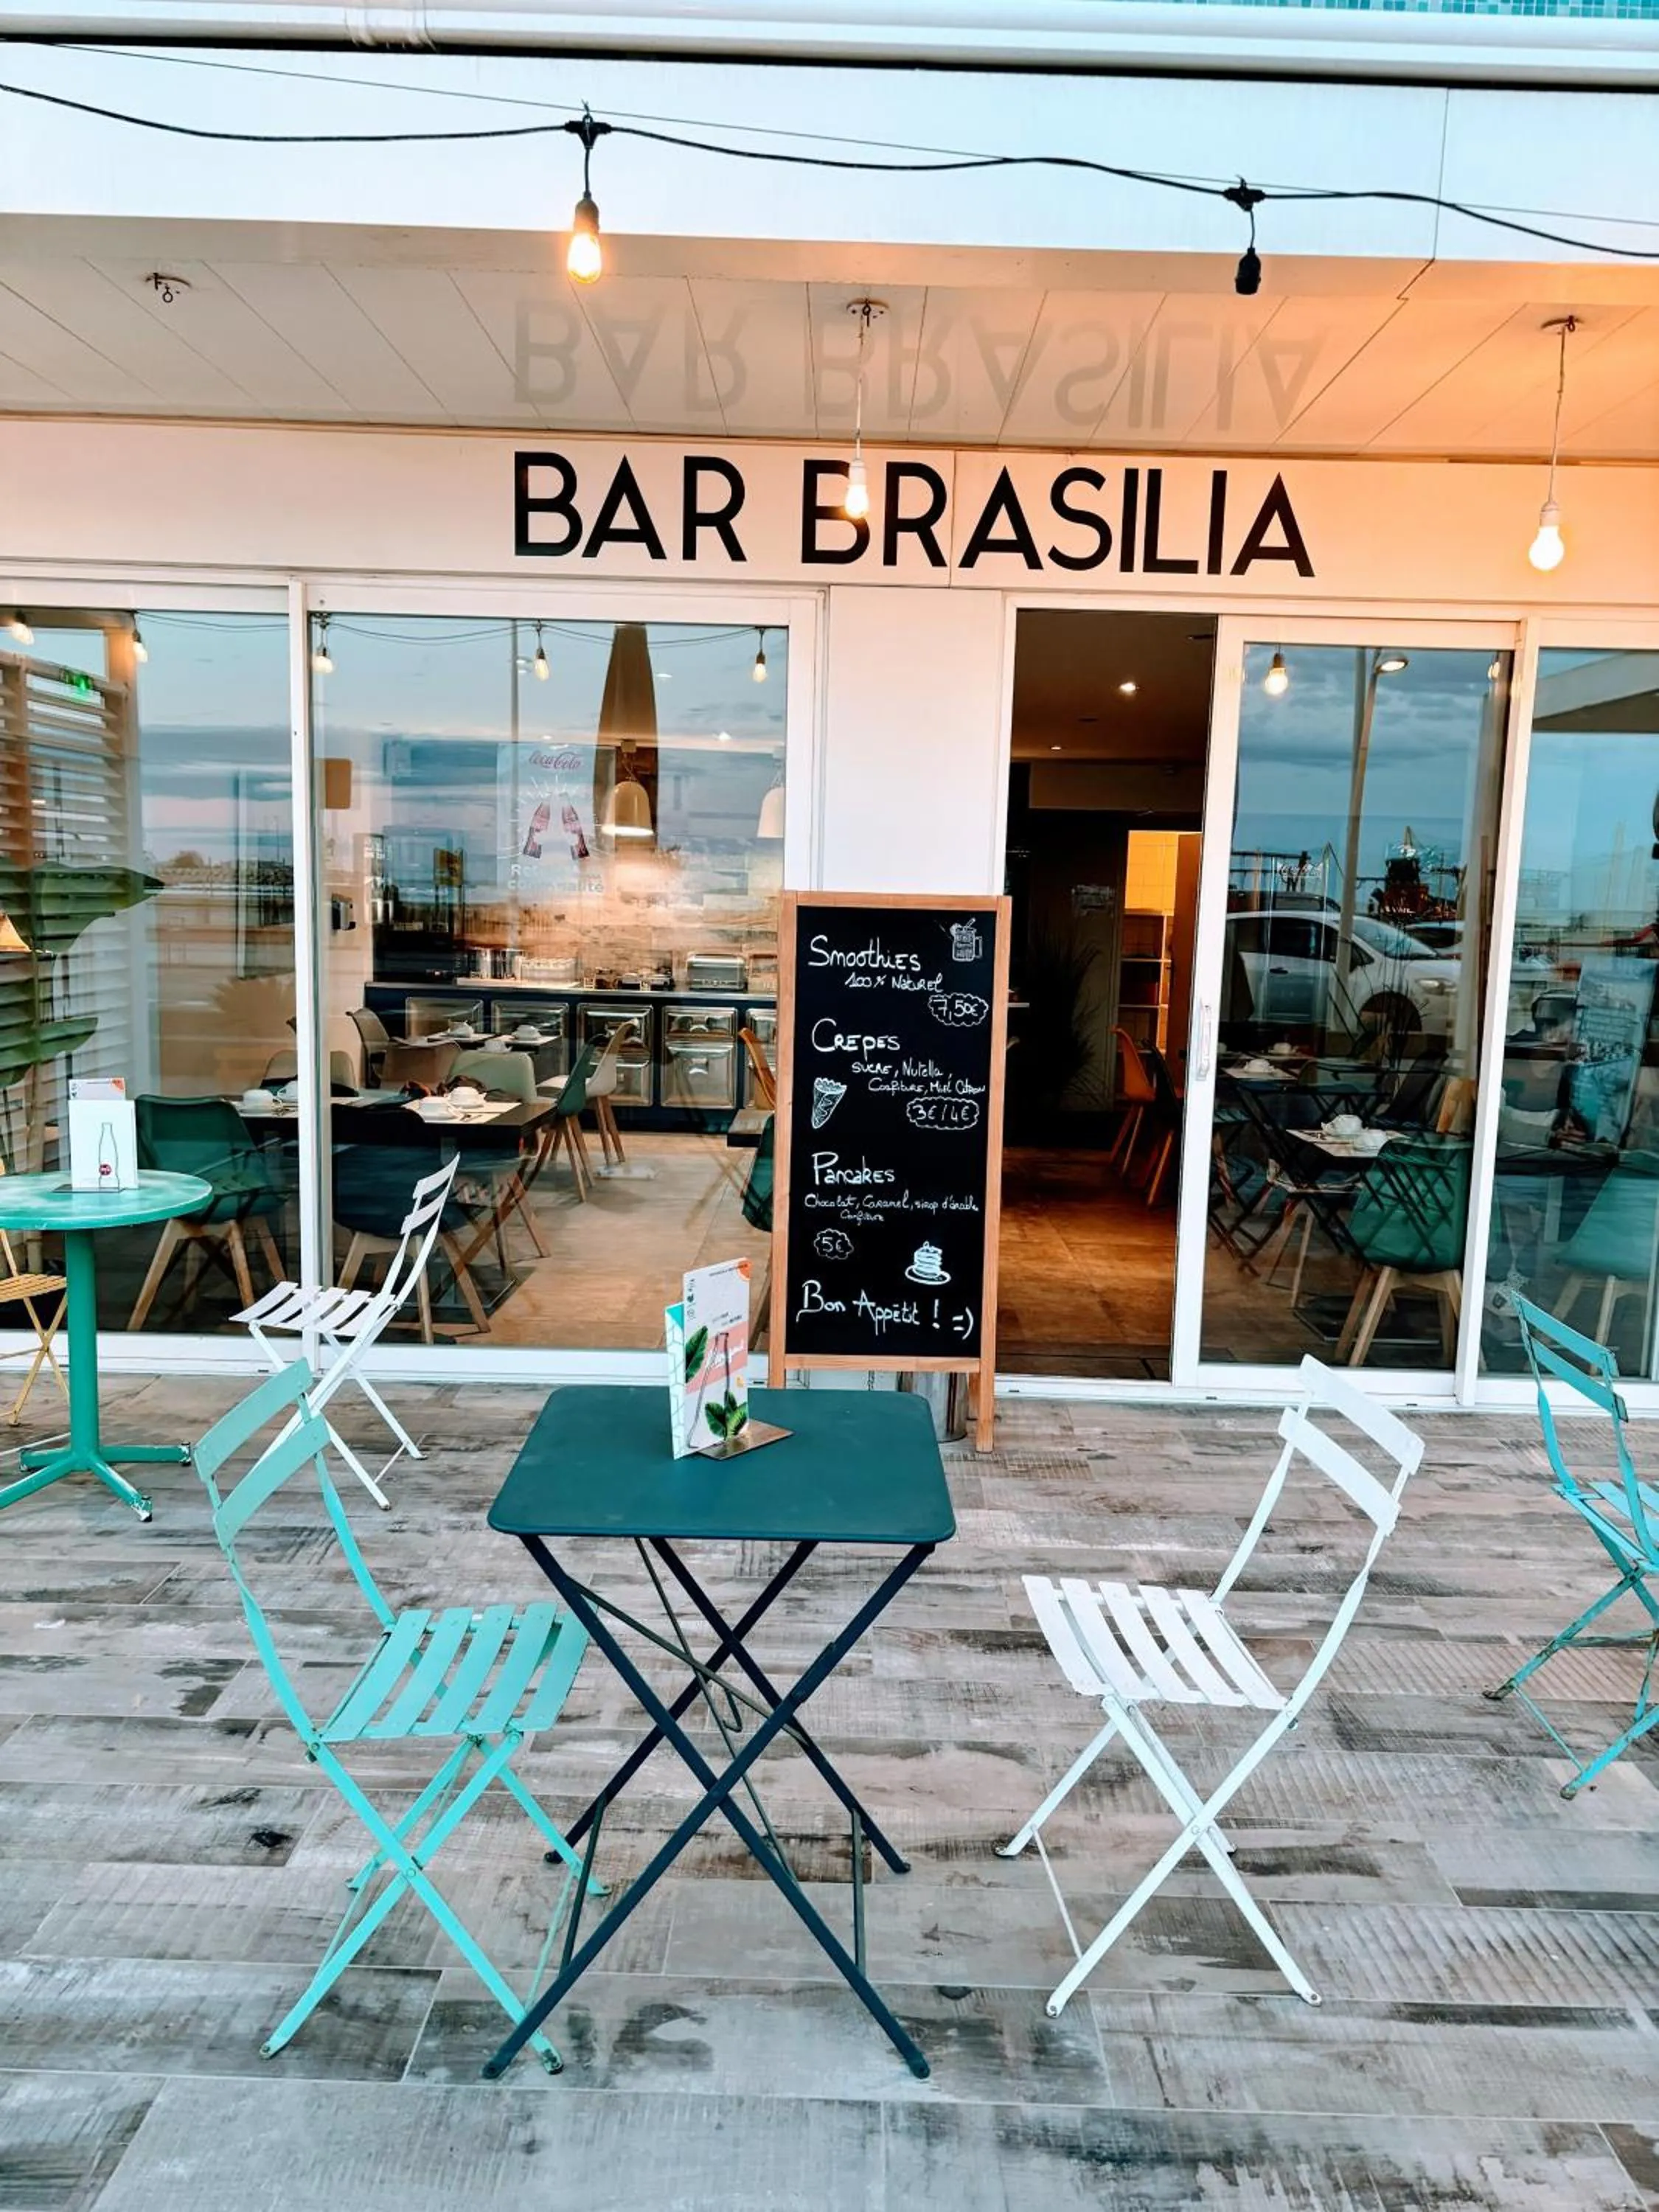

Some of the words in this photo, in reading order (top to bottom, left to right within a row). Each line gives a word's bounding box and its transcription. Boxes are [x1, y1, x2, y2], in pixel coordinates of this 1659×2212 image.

[514, 451, 748, 563] BAR
[801, 457, 1315, 577] BRASILIA
[821, 1237, 845, 1253] 5€
[796, 1279, 846, 1323] Bon
